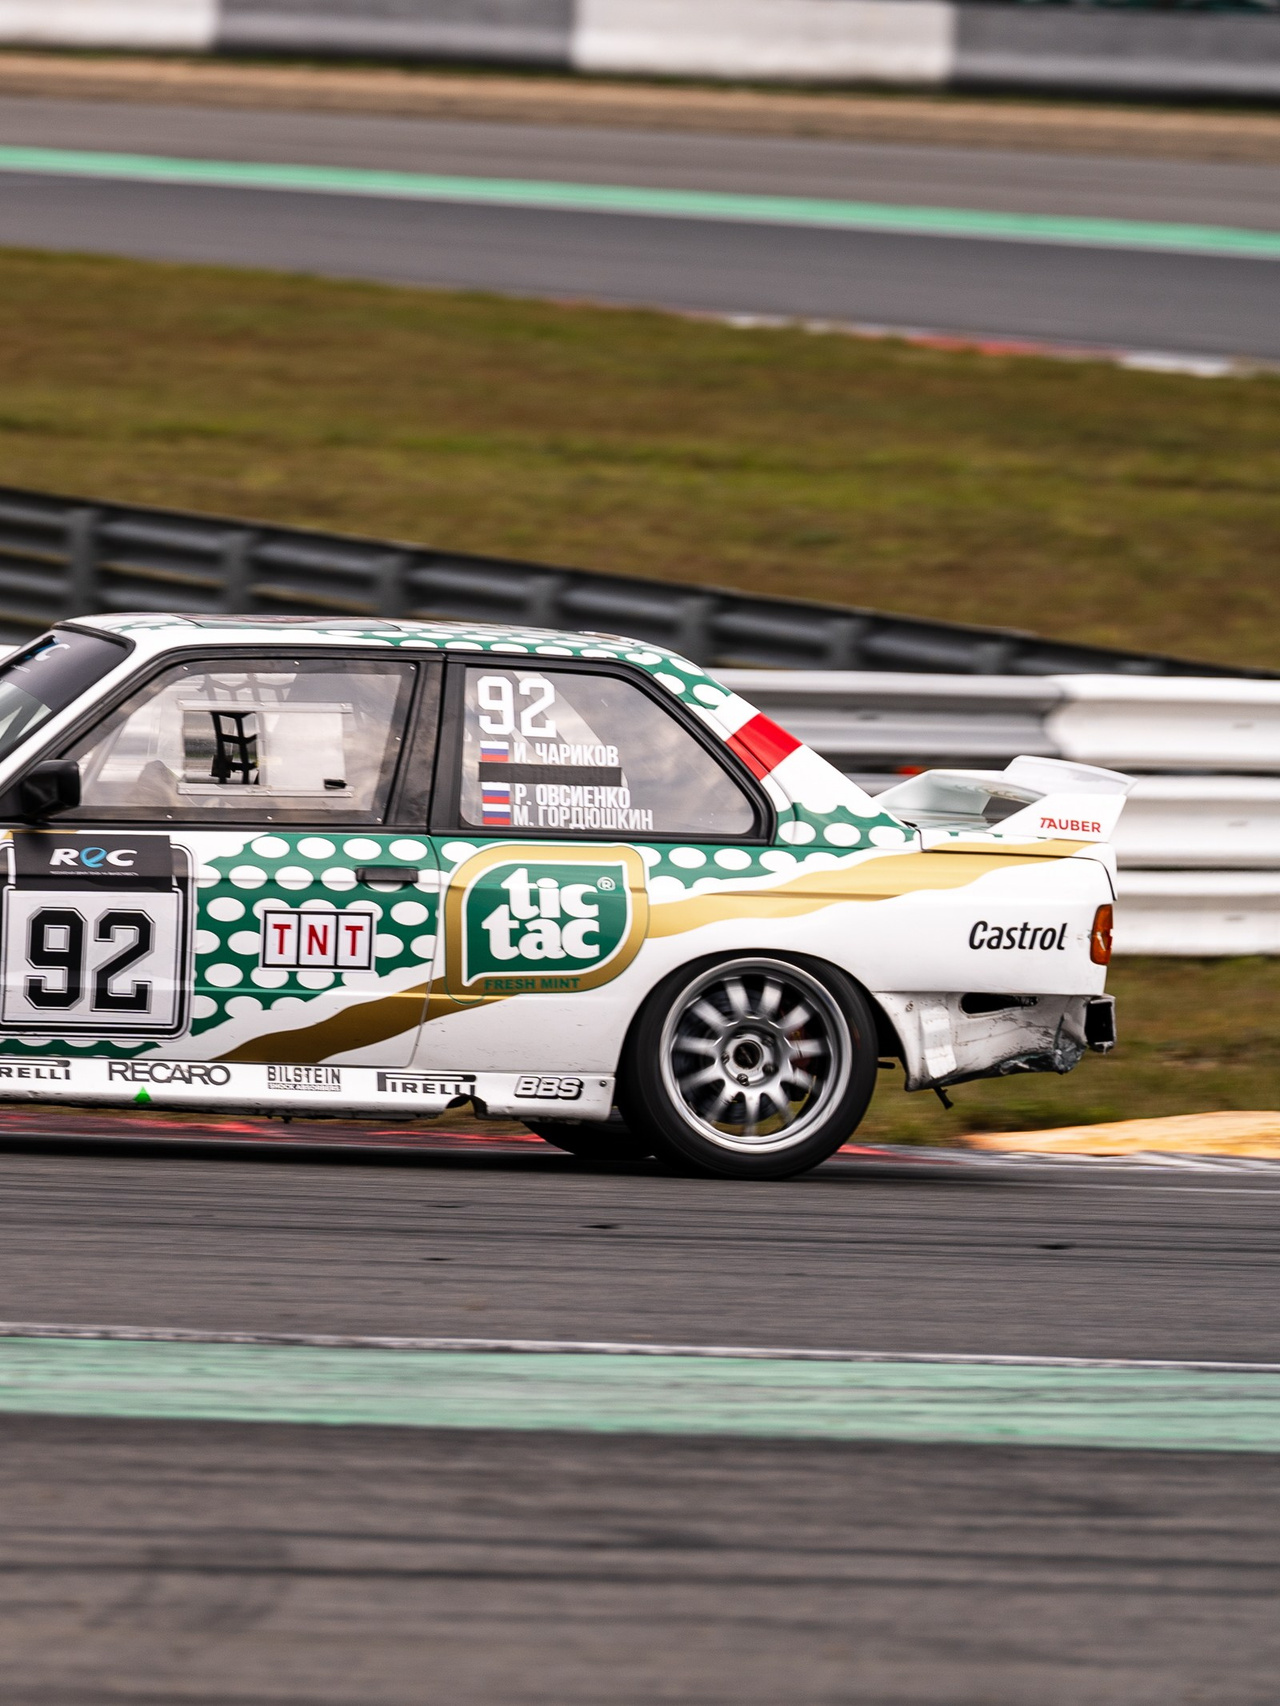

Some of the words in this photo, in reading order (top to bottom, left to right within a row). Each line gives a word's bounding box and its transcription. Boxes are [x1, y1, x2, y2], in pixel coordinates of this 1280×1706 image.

[476, 675, 557, 738] 92
[513, 742, 531, 763] И.
[535, 743, 619, 766] ЧАРИКОВ
[515, 784, 531, 806] Р.
[536, 785, 631, 809] ОВСИЕНКО
[513, 805, 534, 826] М.
[538, 806, 654, 831] ГОРДЮШКИН
[1040, 817, 1101, 834] TAUBER
[501, 867, 600, 919] tic
[272, 922, 365, 957] TNT
[481, 904, 600, 961] tac
[968, 920, 1069, 951] Castrol
[24, 906, 156, 1013] 92
[484, 978, 536, 991] FRESH
[540, 977, 580, 990] MINT
[108, 1060, 231, 1086] RECARO
[267, 1066, 341, 1084] BILSTEIN
[377, 1071, 477, 1097] PIRELLI
[514, 1075, 584, 1100] BBS
